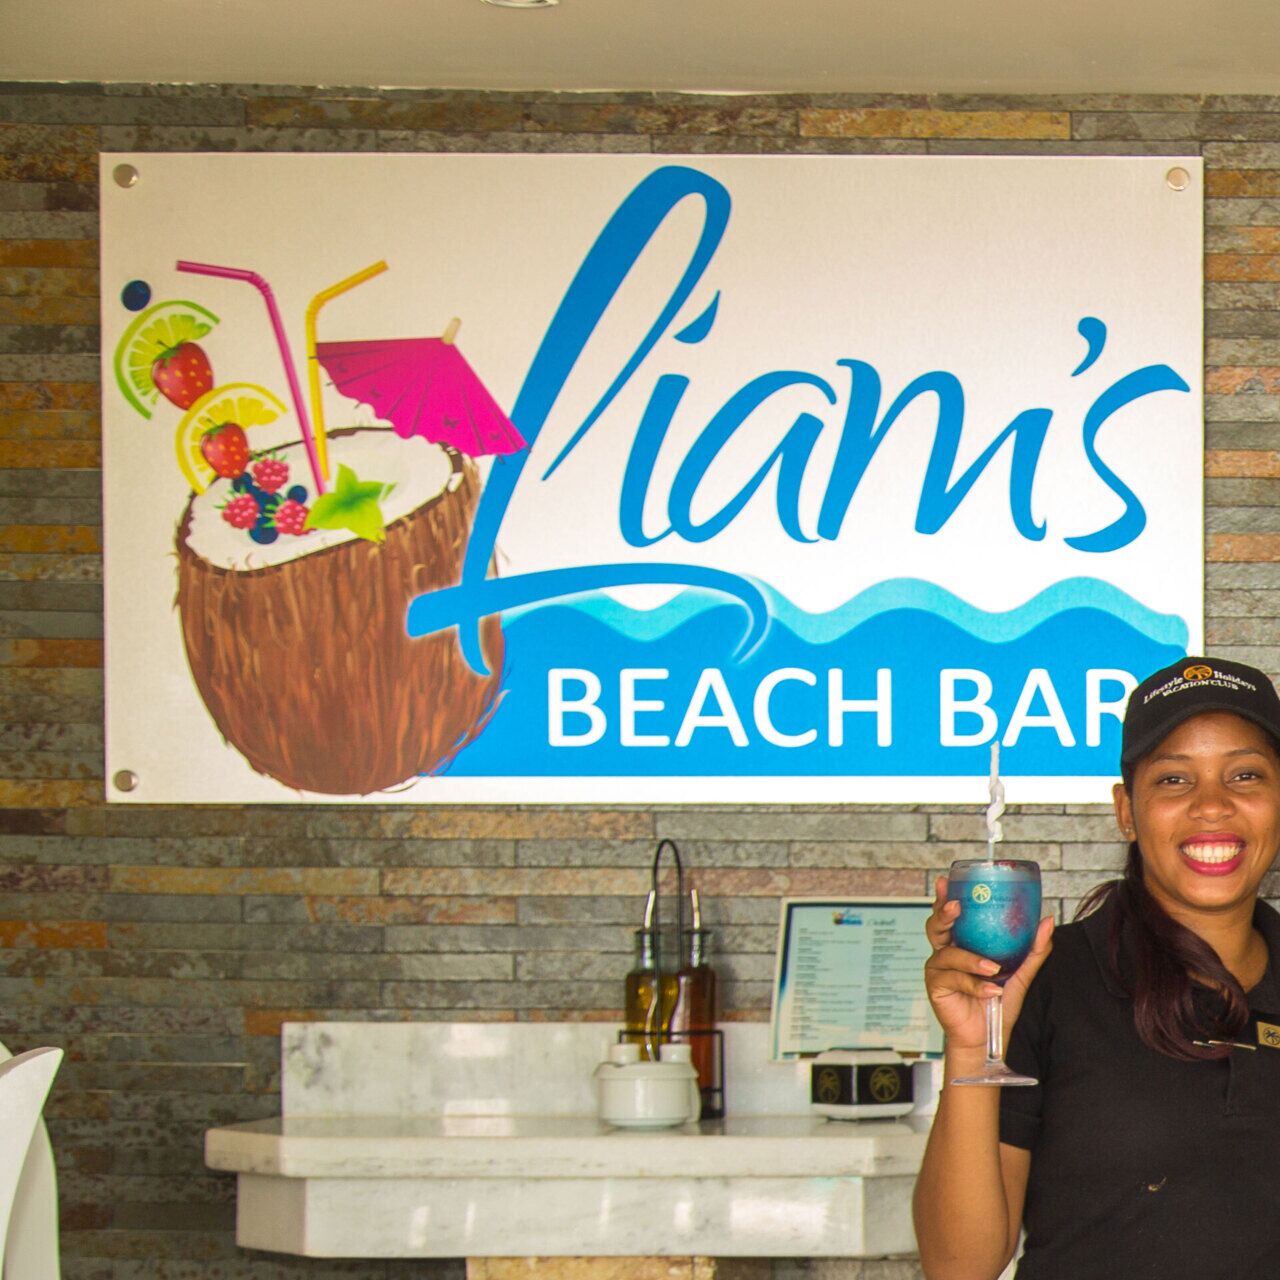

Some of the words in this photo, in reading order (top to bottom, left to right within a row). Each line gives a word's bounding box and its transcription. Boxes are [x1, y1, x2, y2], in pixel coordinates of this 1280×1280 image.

[405, 165, 1191, 676] Liam's
[547, 666, 893, 750] BEACH
[940, 666, 1139, 750] BAR
[1143, 677, 1184, 705] Lifestyle
[1213, 670, 1257, 692] Holidays
[1162, 679, 1209, 698] VACATION
[1211, 679, 1239, 691] CLUB
